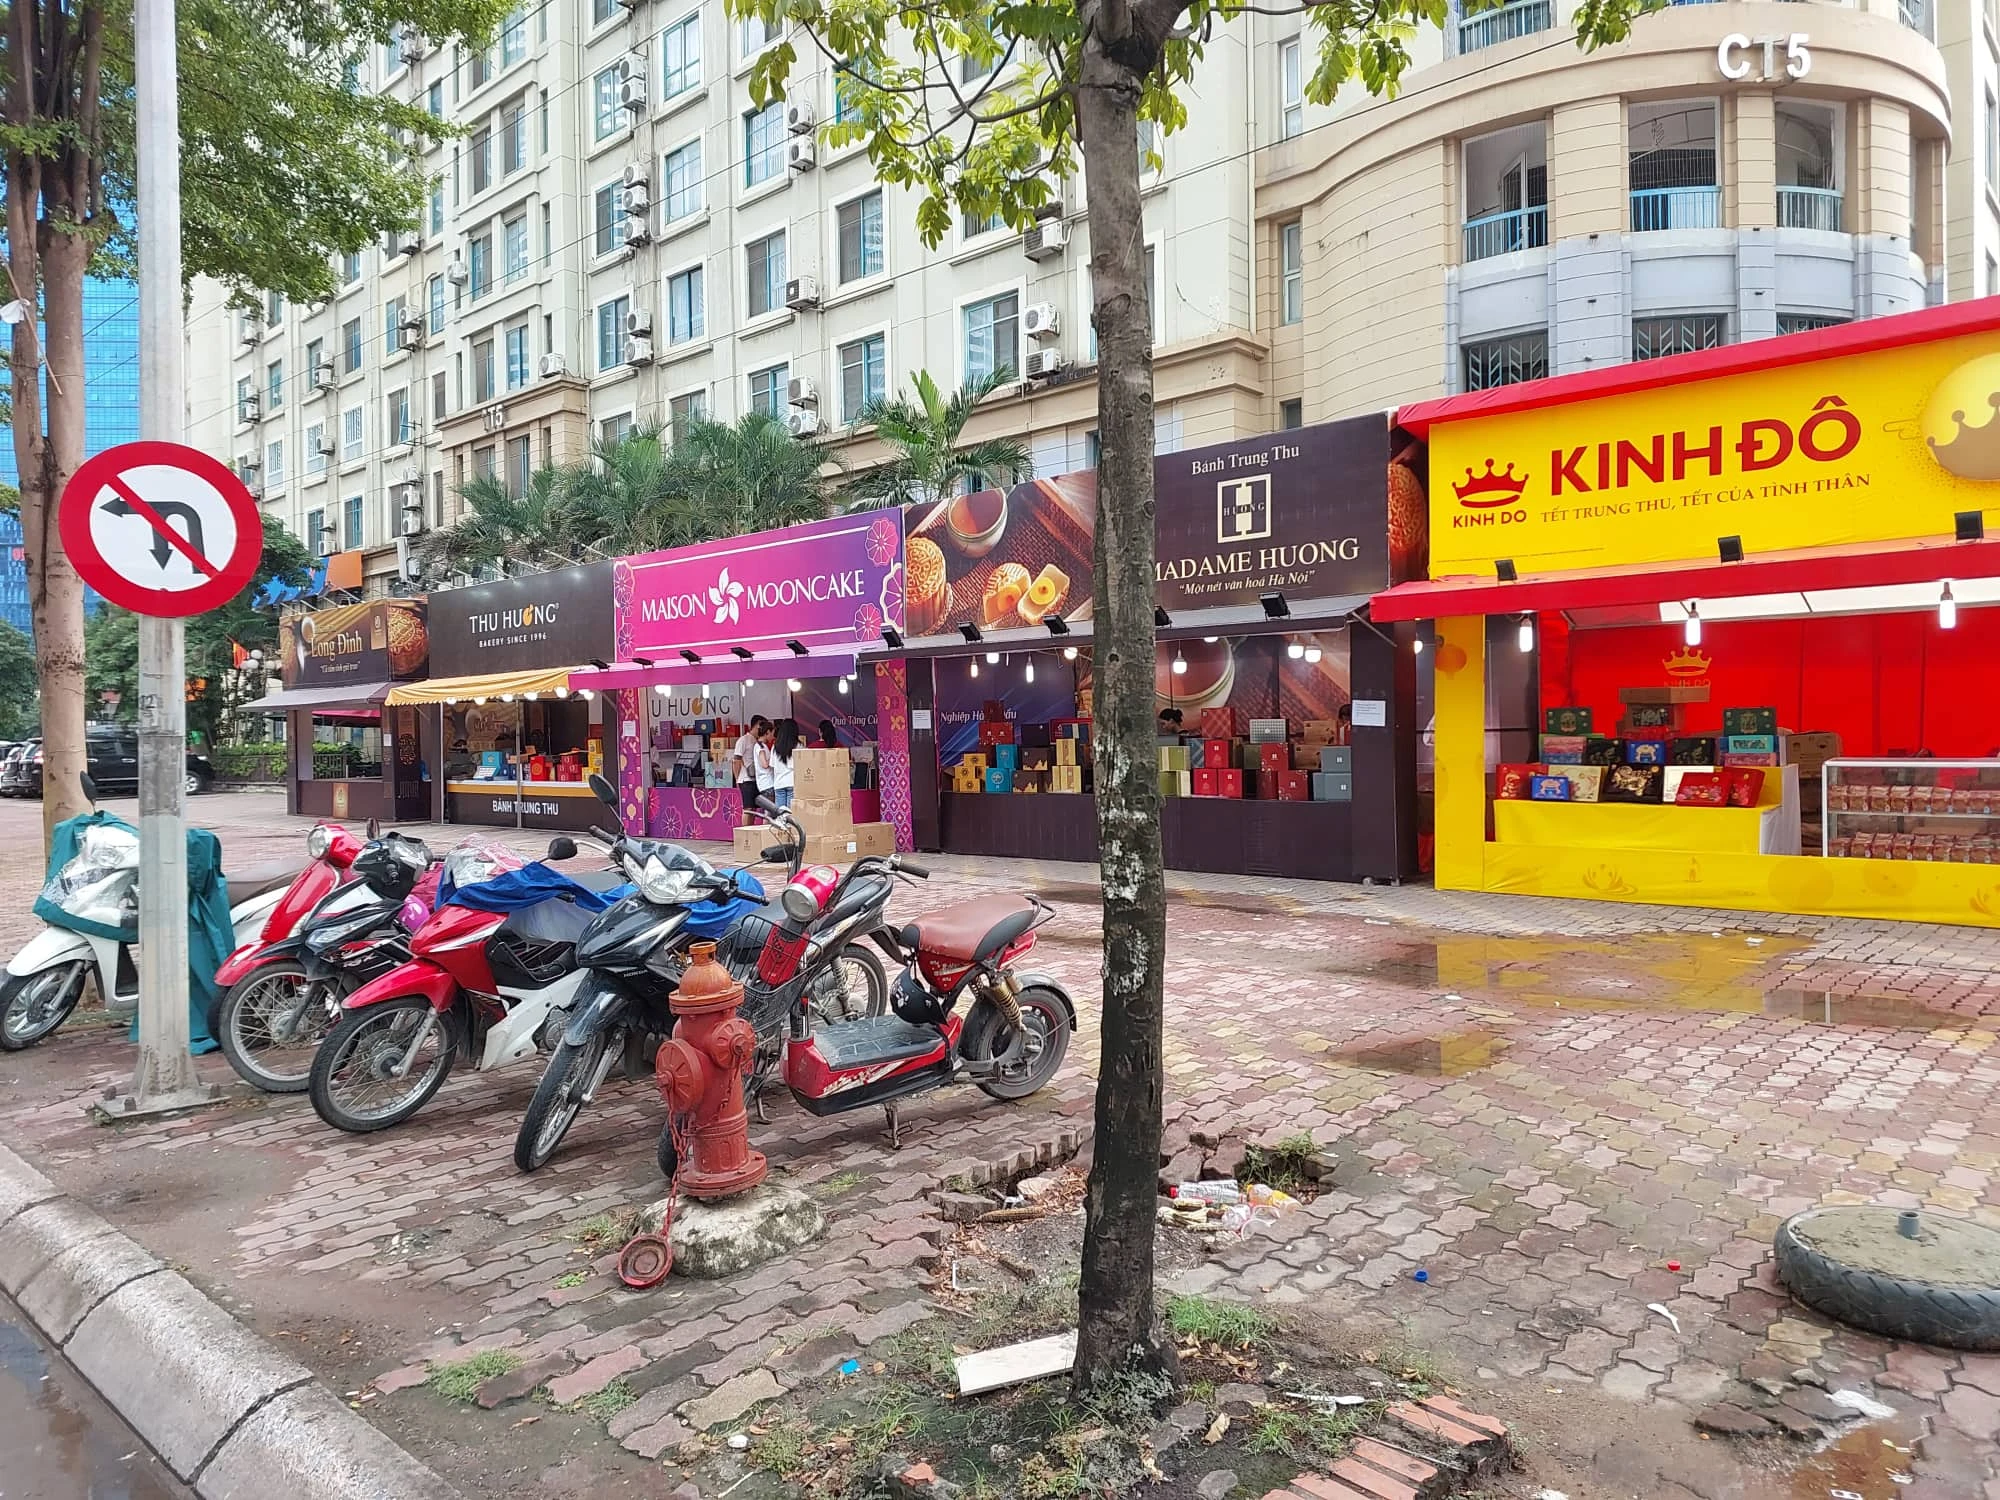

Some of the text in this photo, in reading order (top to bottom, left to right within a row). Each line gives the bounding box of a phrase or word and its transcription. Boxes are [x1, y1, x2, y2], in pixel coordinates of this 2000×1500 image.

[1717, 33, 1812, 80] CT5
[1551, 395, 1862, 496] KINH ĐÔ
[1191, 445, 1300, 475] Bánh Trung Thu
[1540, 472, 1871, 523] TẾT TRUNG THU, TẾT CỦA TÌNH THÂN
[1453, 510, 1527, 528] KINH DO
[1258, 537, 1361, 569] HUONG
[1206, 580, 1222, 593] nét
[1268, 573, 1285, 586] Hà
[641, 569, 865, 622] MAISON MOONCAKE
[469, 612, 498, 634] THU
[311, 637, 336, 661] Long
[479, 632, 546, 648] BAKERY SINCE 1996
[940, 711, 970, 724] Nghiệp
[972, 710, 985, 721] Hà
[541, 802, 559, 816] THU
